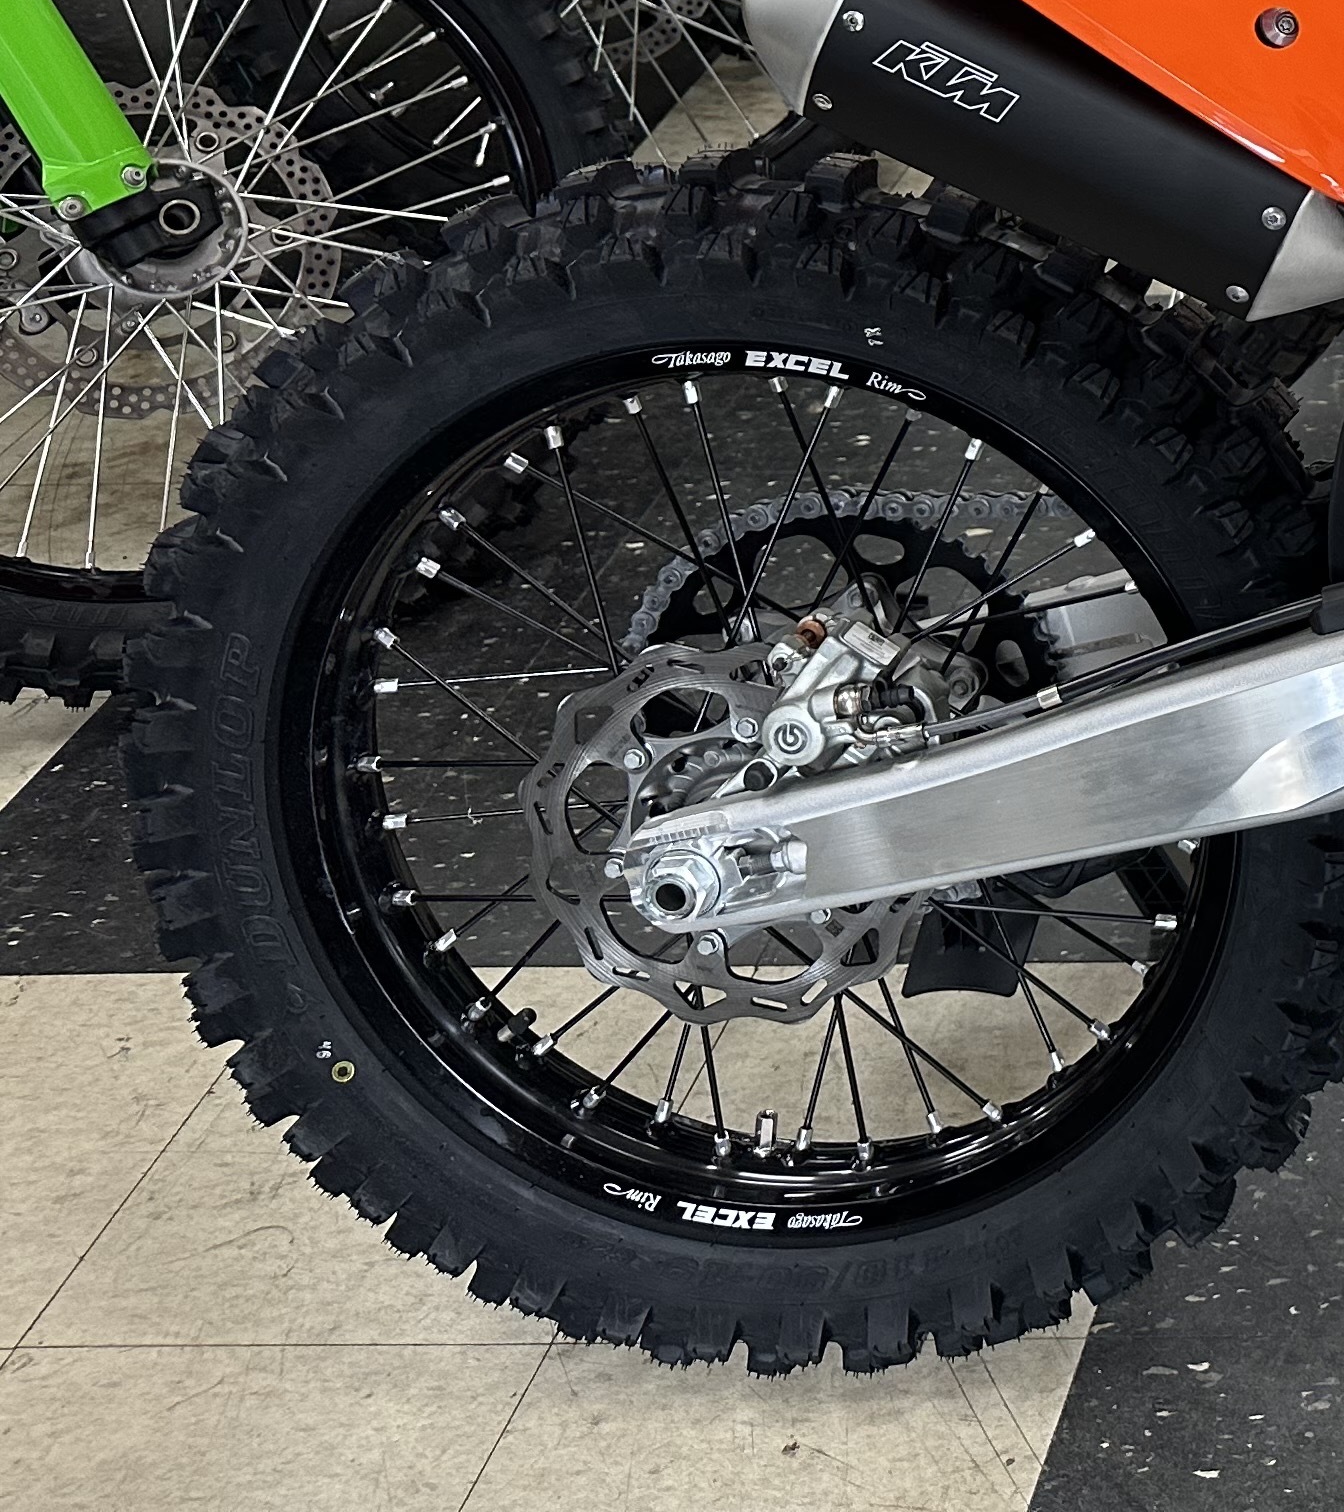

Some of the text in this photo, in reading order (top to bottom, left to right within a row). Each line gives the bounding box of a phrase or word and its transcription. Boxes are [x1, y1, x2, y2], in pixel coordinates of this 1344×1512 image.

[872, 39, 1020, 123] KTM
[651, 349, 927, 401] Takasago EXCEL Rim
[603, 1181, 863, 1231] Takasago EXCEL Rim
